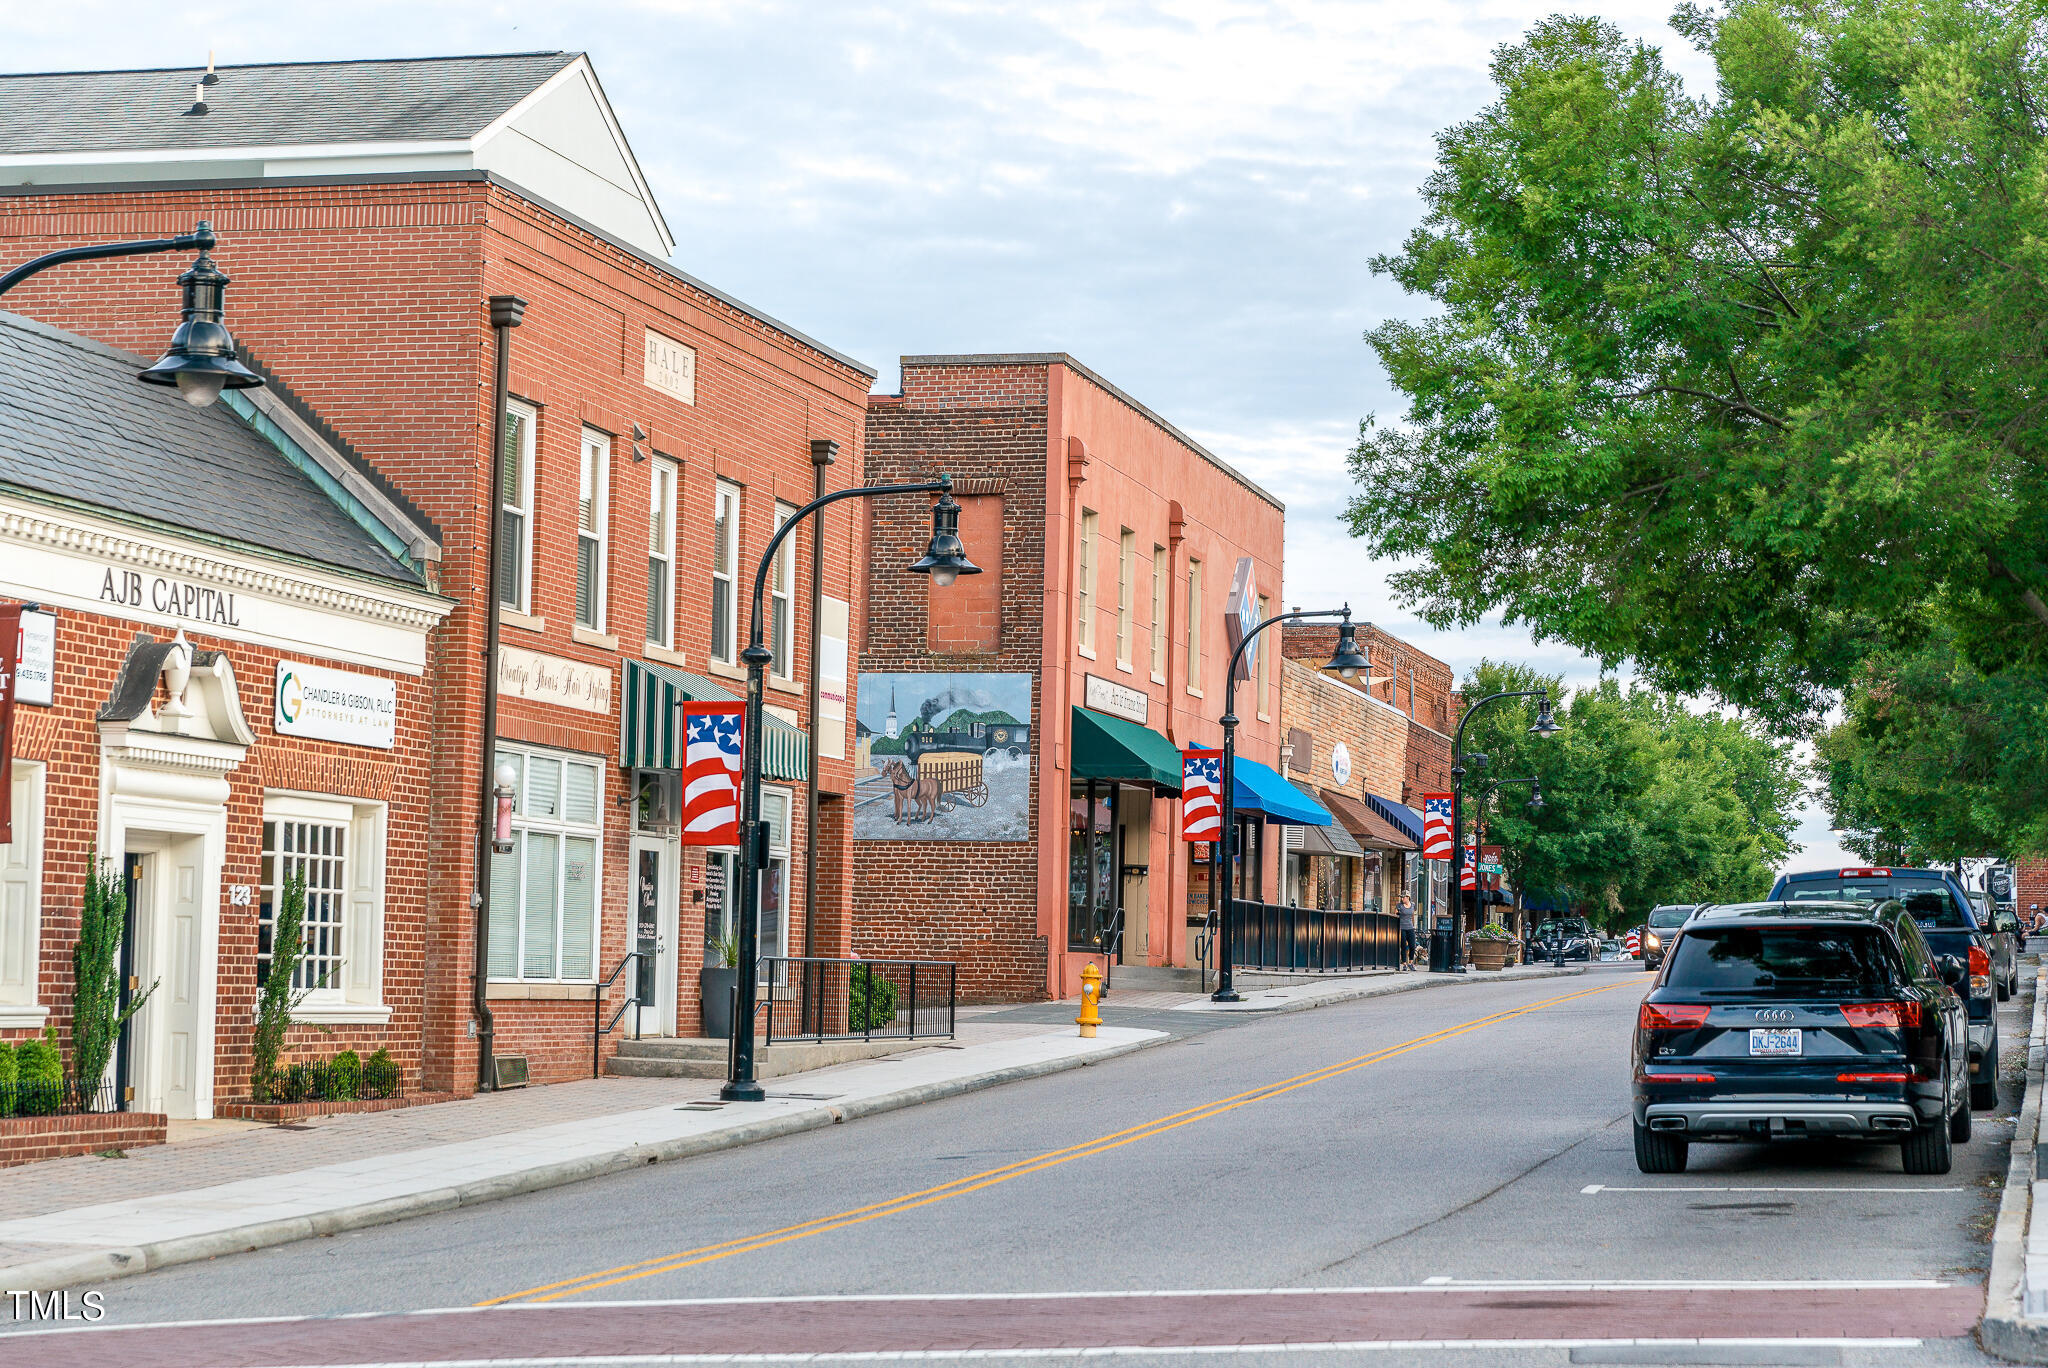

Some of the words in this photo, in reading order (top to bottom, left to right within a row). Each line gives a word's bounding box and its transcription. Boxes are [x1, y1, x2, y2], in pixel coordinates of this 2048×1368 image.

[649, 341, 688, 378] HALE
[100, 567, 142, 606] AJB
[152, 578, 239, 626] CAPITAL
[303, 686, 340, 705] CHANDLER
[341, 693, 346, 706] &
[377, 699, 392, 713] PLLC
[306, 708, 353, 723] ATTORNEYS
[359, 716, 368, 725] AT
[373, 719, 389, 728] LAW
[1479, 864, 1496, 872] JONES
[229, 885, 251, 906] 123
[1659, 1047, 1676, 1055] Q7
[1752, 1035, 1798, 1049] DKJ-2644
